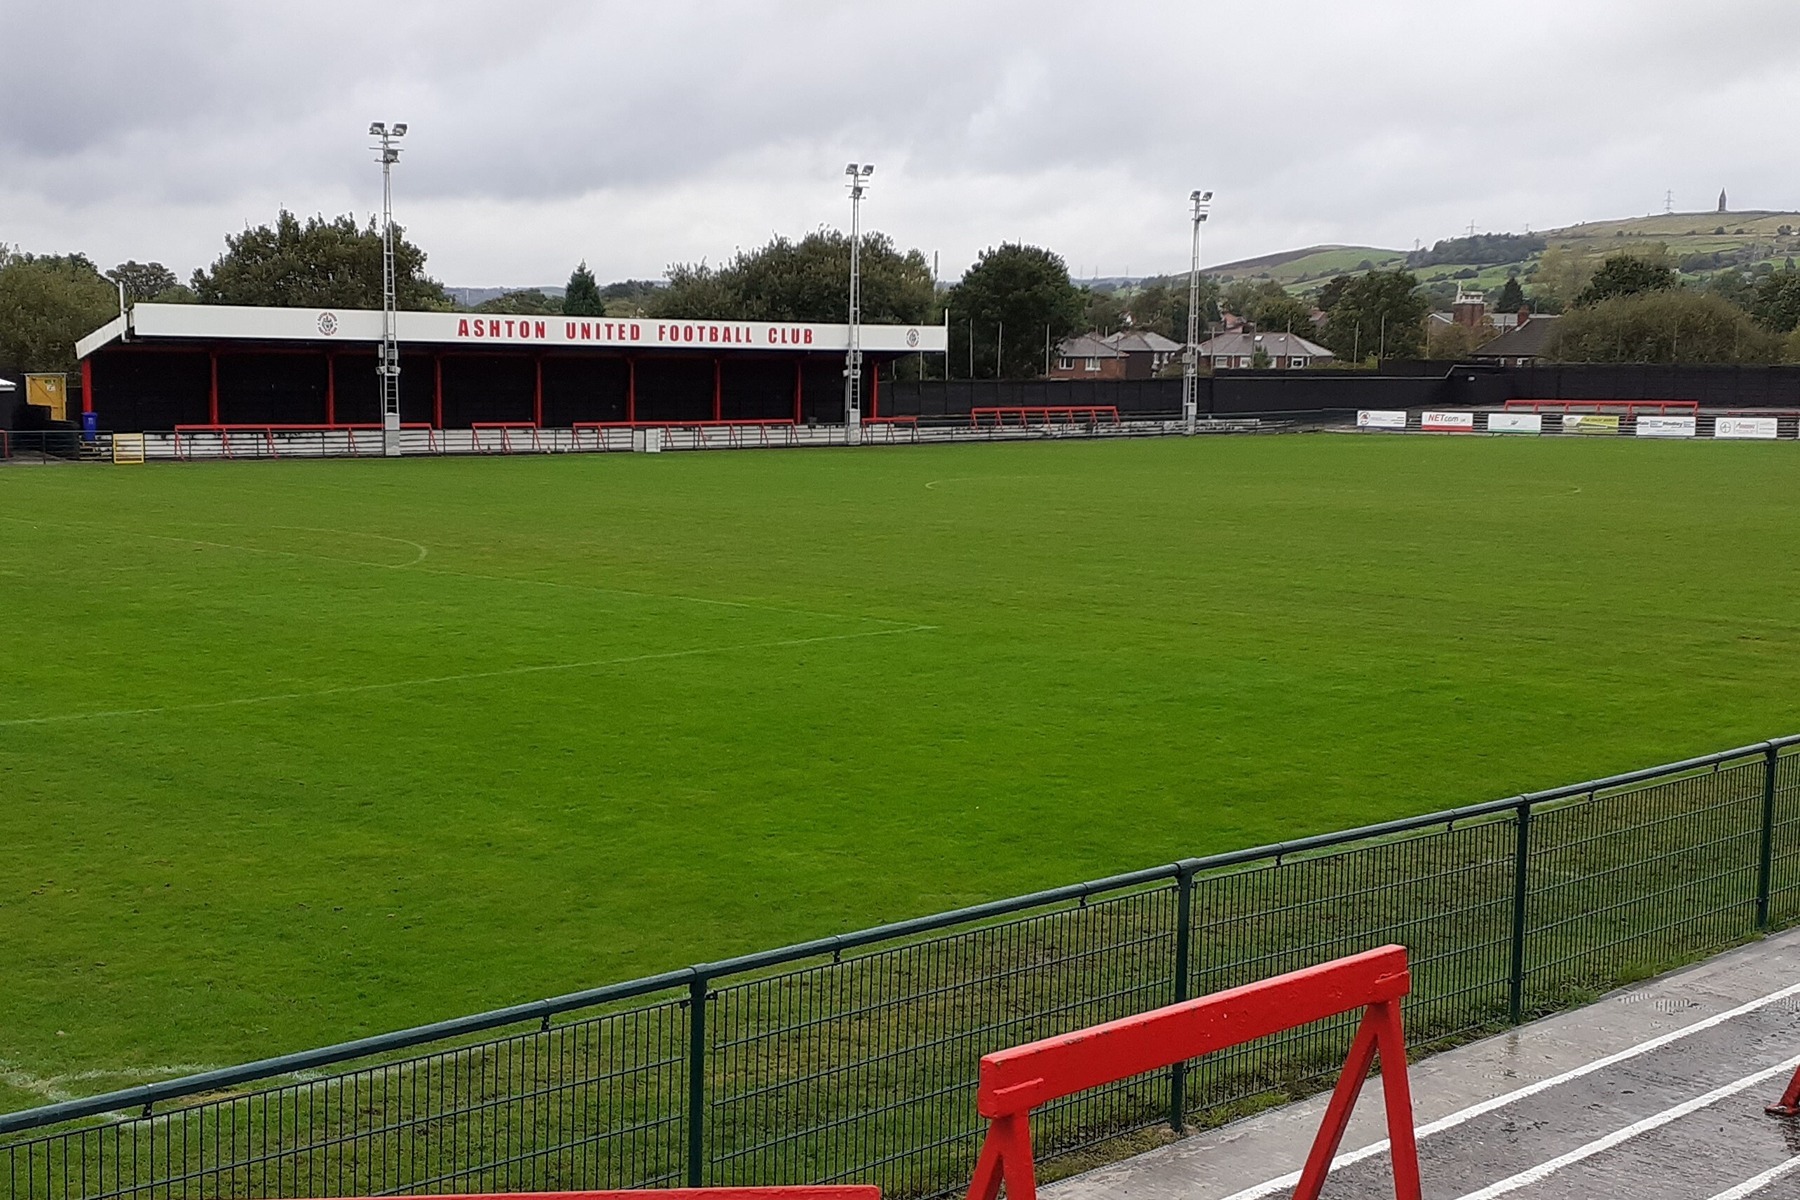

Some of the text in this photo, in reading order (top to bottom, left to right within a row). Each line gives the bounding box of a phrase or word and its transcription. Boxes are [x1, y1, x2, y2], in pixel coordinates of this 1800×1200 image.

[458, 319, 813, 345] ASHTON UNITED FOOTBALL CLUB
